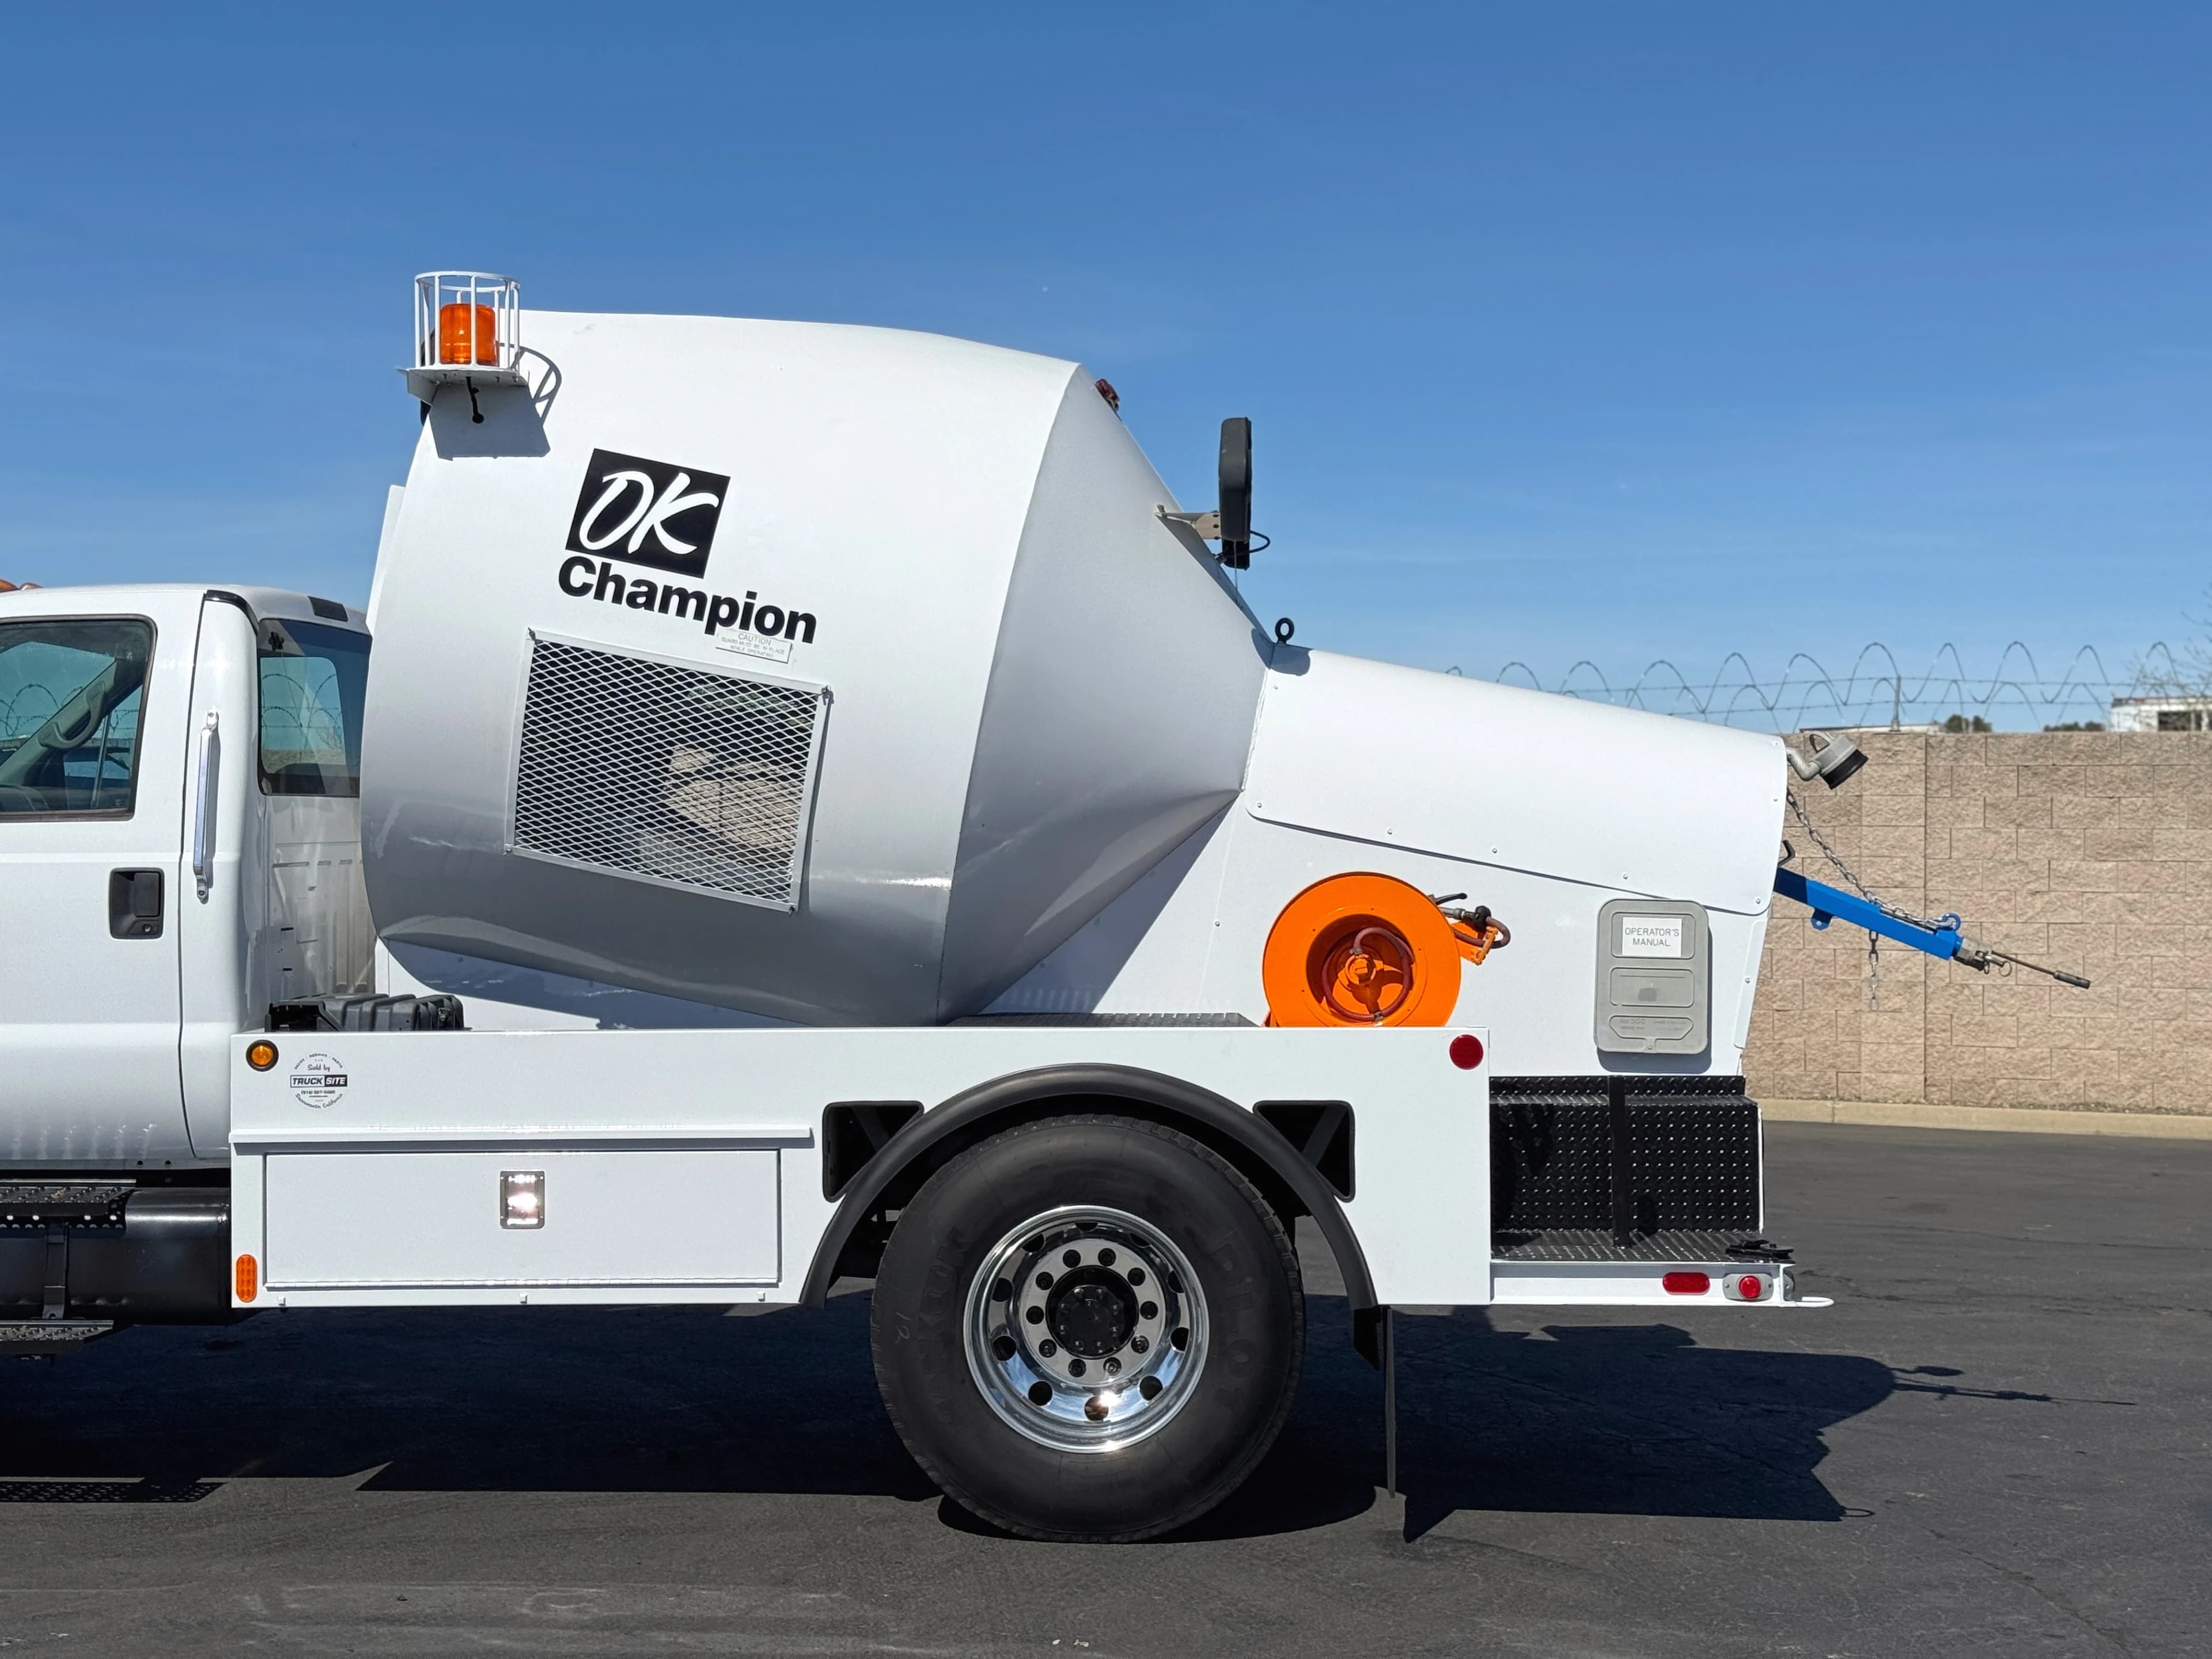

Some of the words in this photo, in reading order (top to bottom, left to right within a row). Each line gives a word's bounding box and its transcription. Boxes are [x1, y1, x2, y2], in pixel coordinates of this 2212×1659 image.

[558, 556, 817, 645] Champion
[738, 633, 772, 646] CAUTION
[768, 646, 785, 655] PLACE
[1624, 927, 1679, 937] OPERATOR'S
[1632, 938, 1671, 946] MANUAL
[323, 1063, 331, 1072] by
